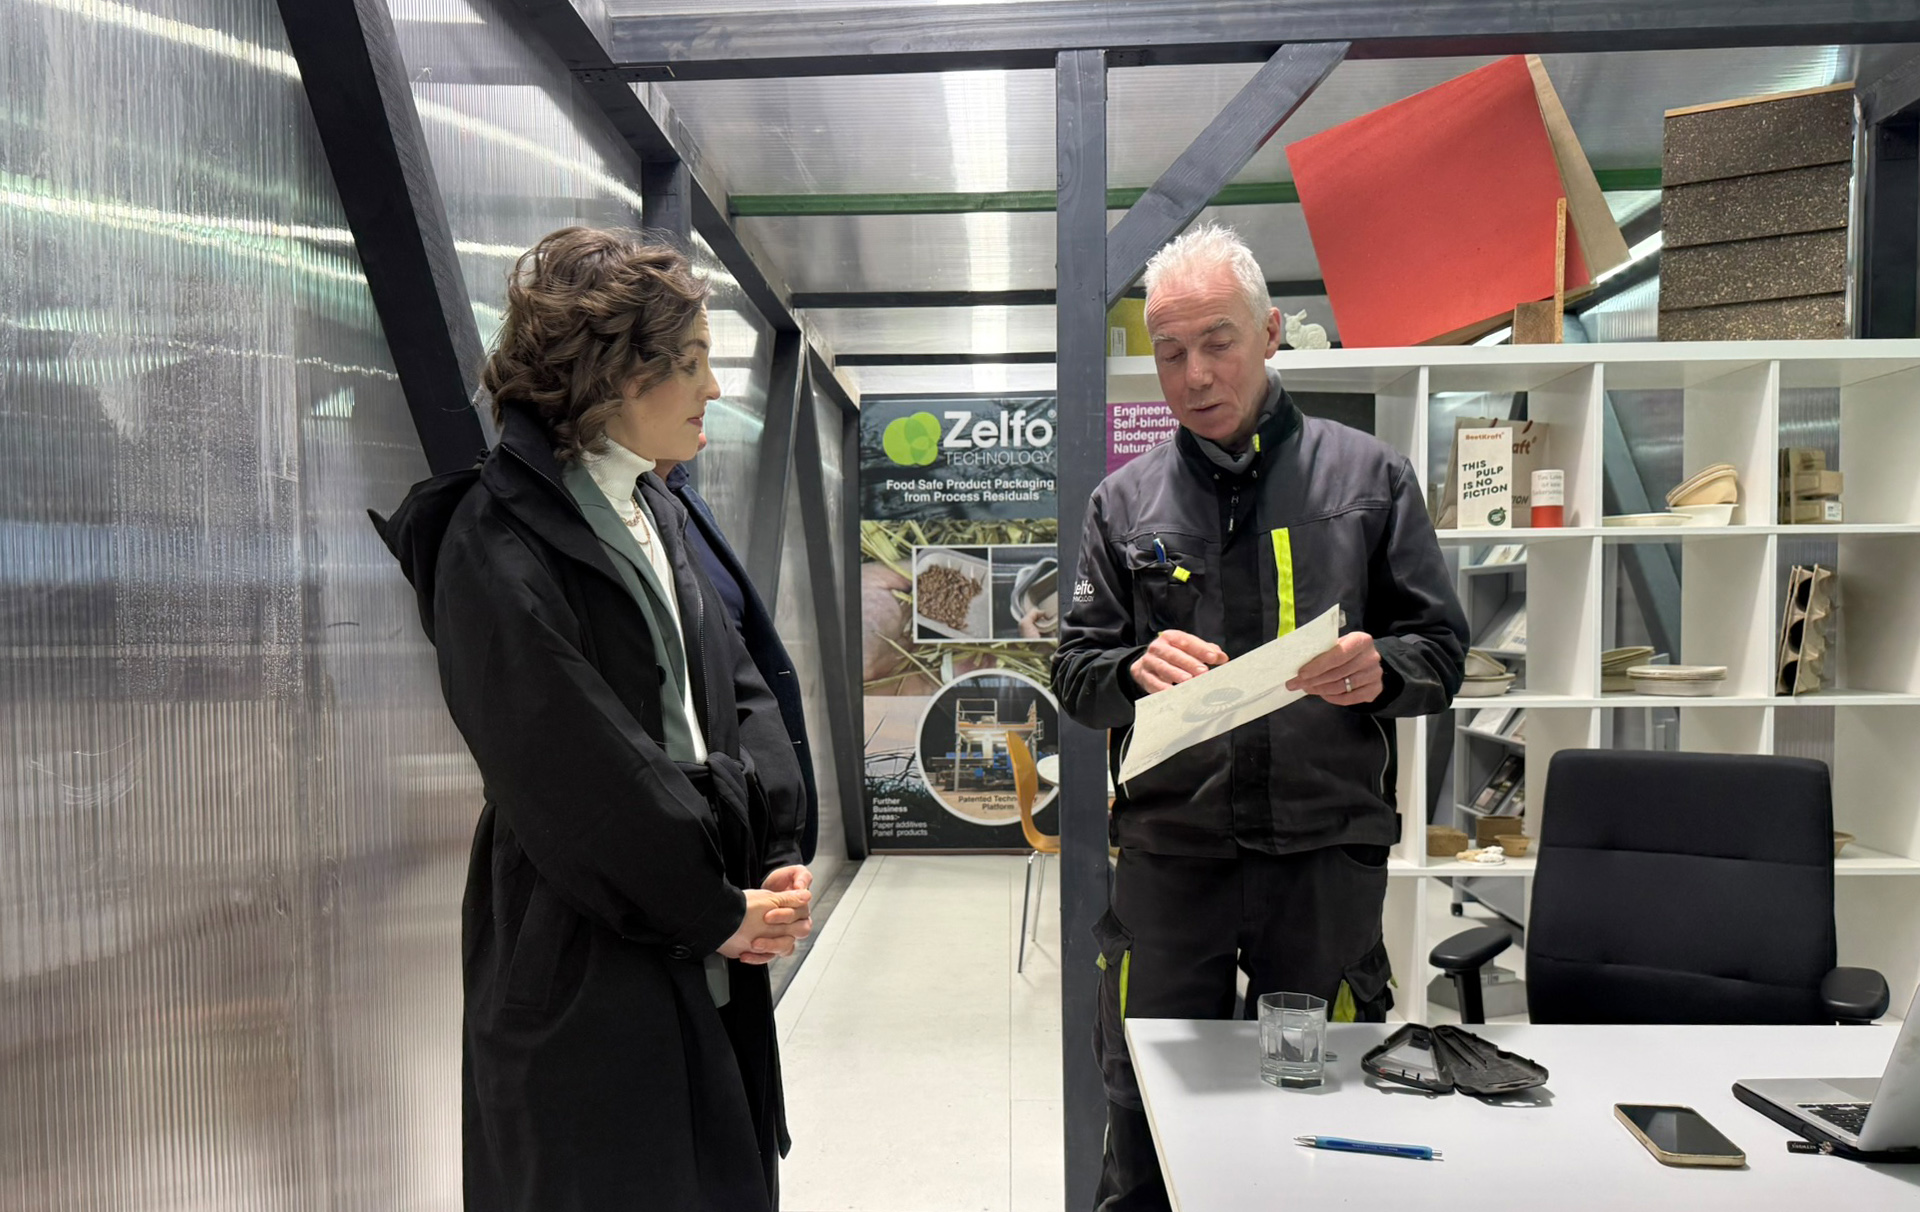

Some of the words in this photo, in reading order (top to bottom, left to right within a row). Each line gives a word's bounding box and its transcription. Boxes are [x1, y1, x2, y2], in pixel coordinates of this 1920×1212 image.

[944, 450, 1053, 466] TECHNOLOGY
[1462, 460, 1486, 471] THIS
[1476, 466, 1503, 478] PULP
[886, 479, 915, 490] Food
[918, 478, 943, 490] Safe
[946, 478, 991, 490] Product
[994, 477, 1055, 491] Packaging
[1463, 481, 1473, 490] IS
[1476, 478, 1492, 488] NO
[904, 491, 931, 502] from
[933, 491, 980, 502] Process
[983, 490, 1039, 501] Residuals
[1463, 484, 1508, 500] FICTION
[873, 797, 901, 805] Further
[982, 803, 1014, 811] Platform
[873, 821, 894, 829] Paper
[873, 829, 893, 837] Panel
[896, 829, 928, 838] products
